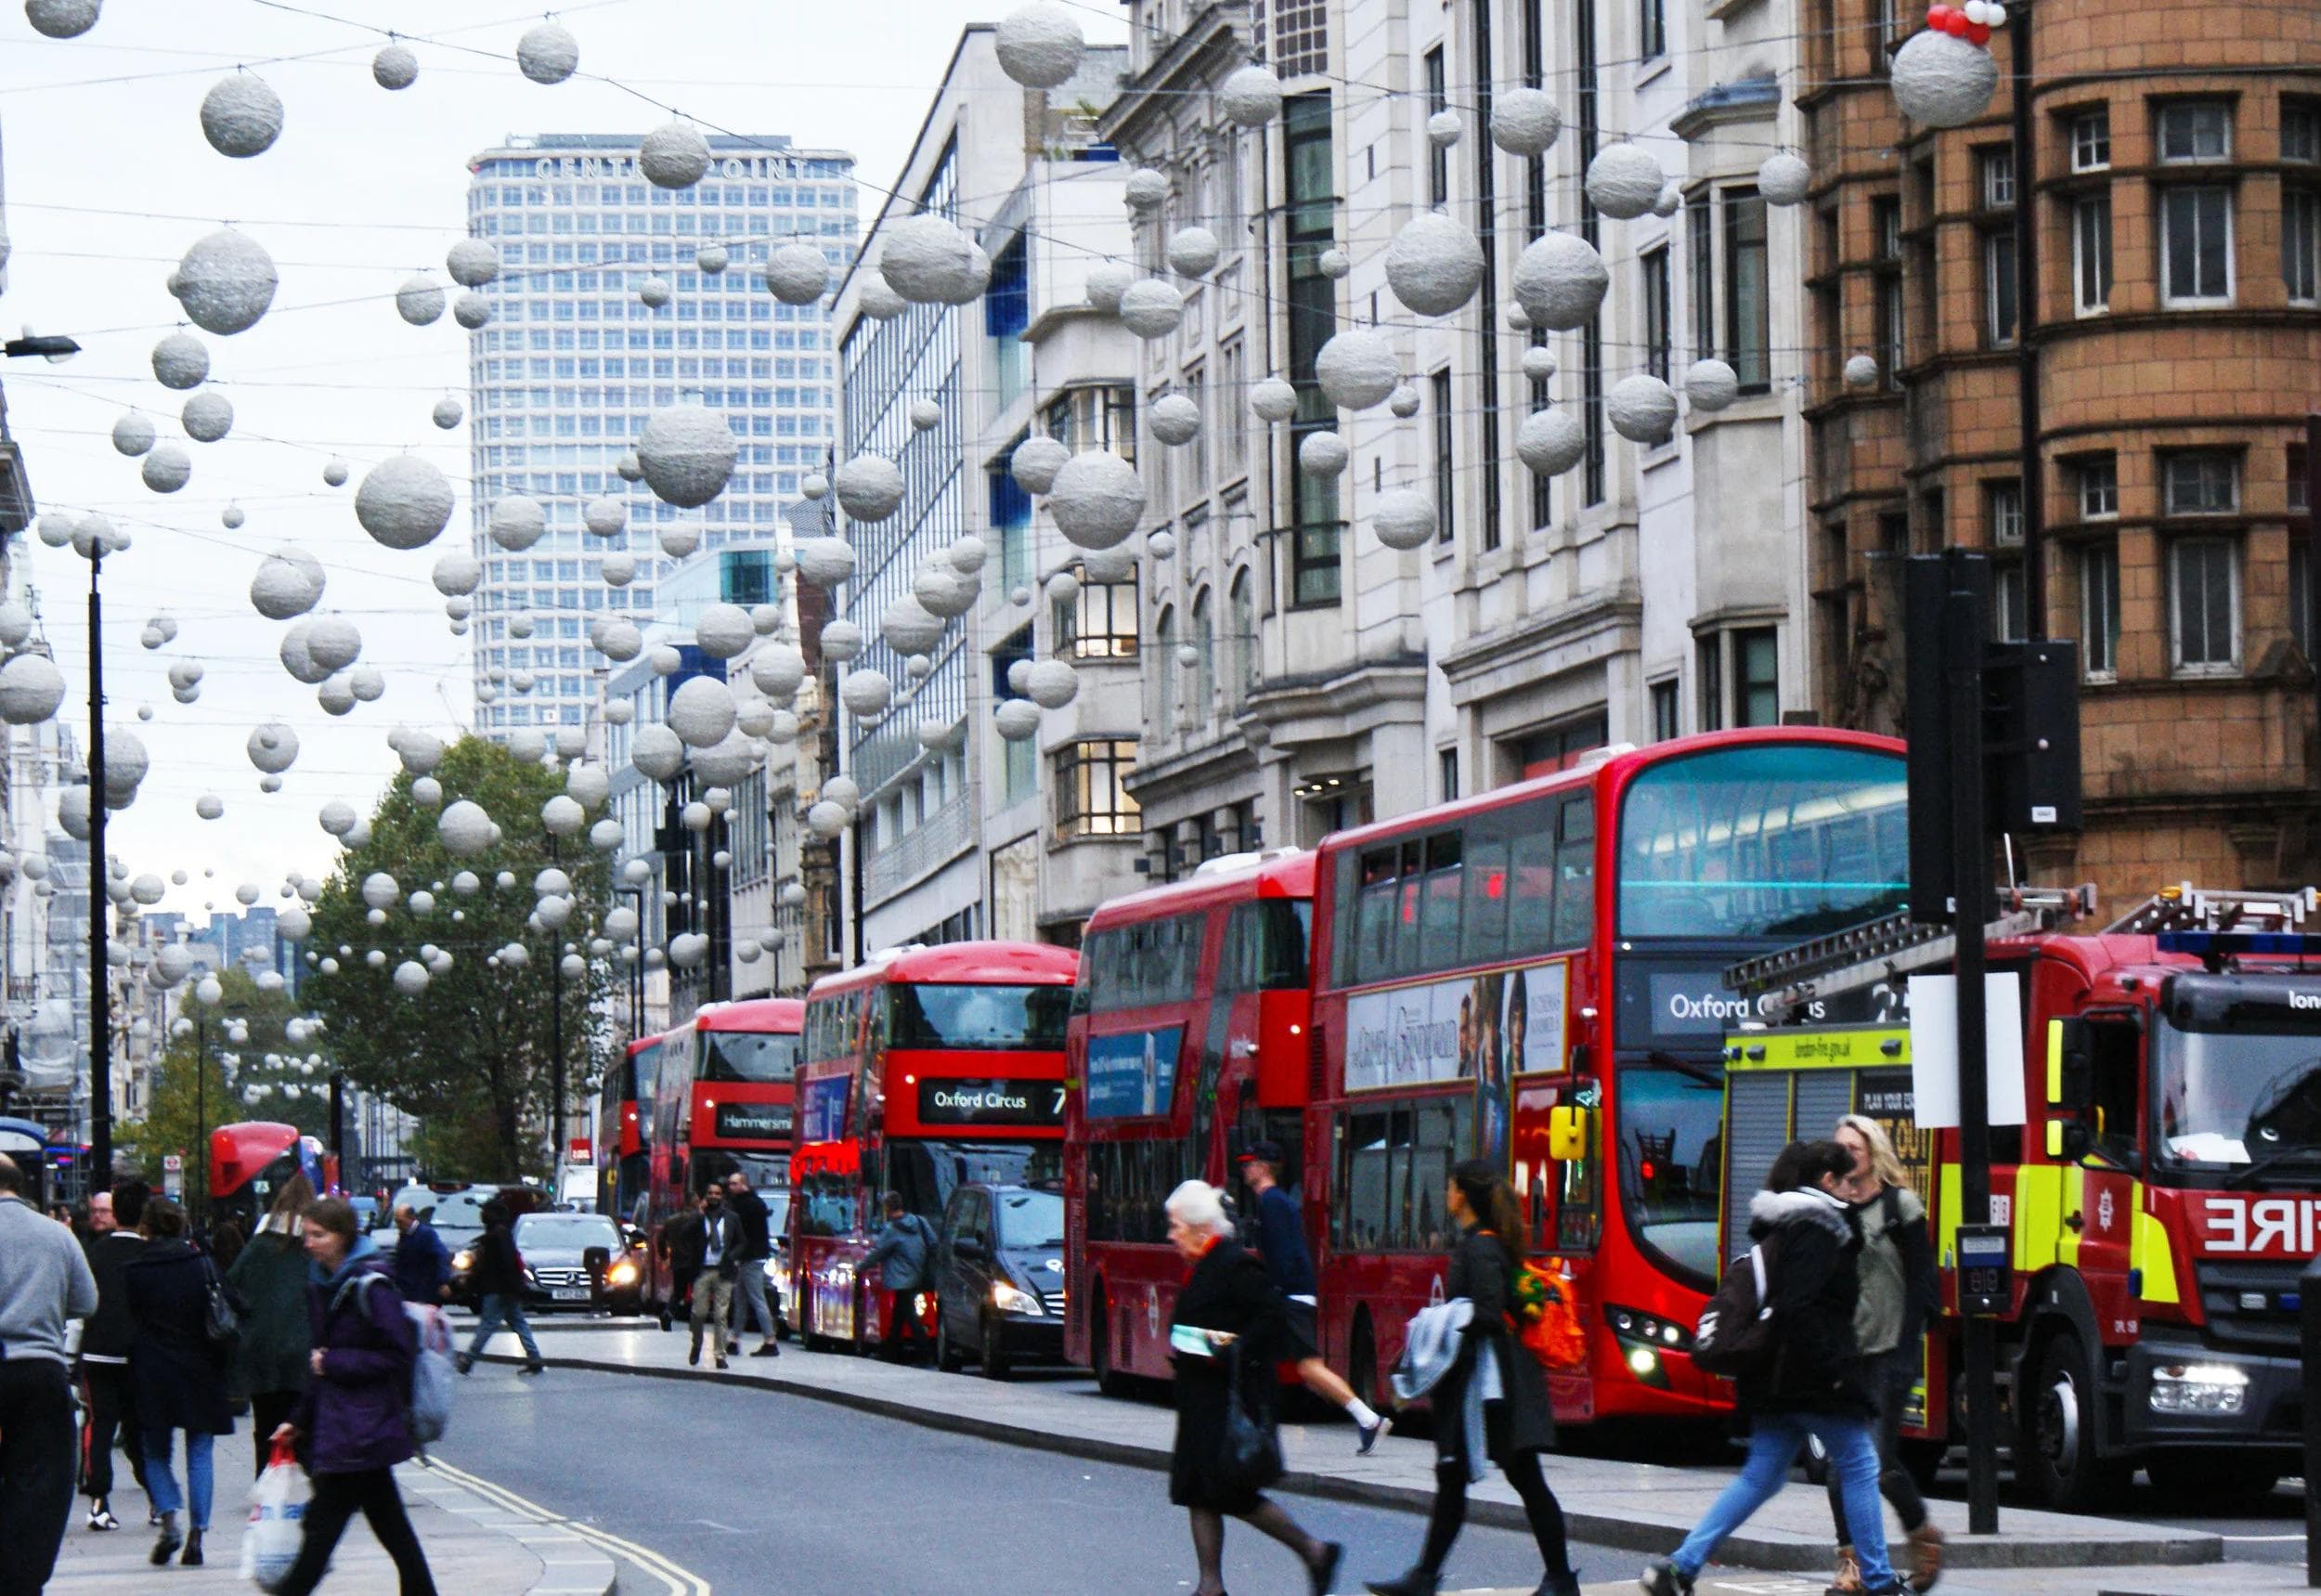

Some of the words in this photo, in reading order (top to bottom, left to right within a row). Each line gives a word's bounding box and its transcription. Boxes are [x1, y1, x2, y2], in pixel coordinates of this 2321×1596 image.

[1670, 993, 1749, 1019] Oxford
[2289, 990, 2321, 1009] lon
[934, 1091, 981, 1108] Oxford
[985, 1092, 1026, 1109] Circus
